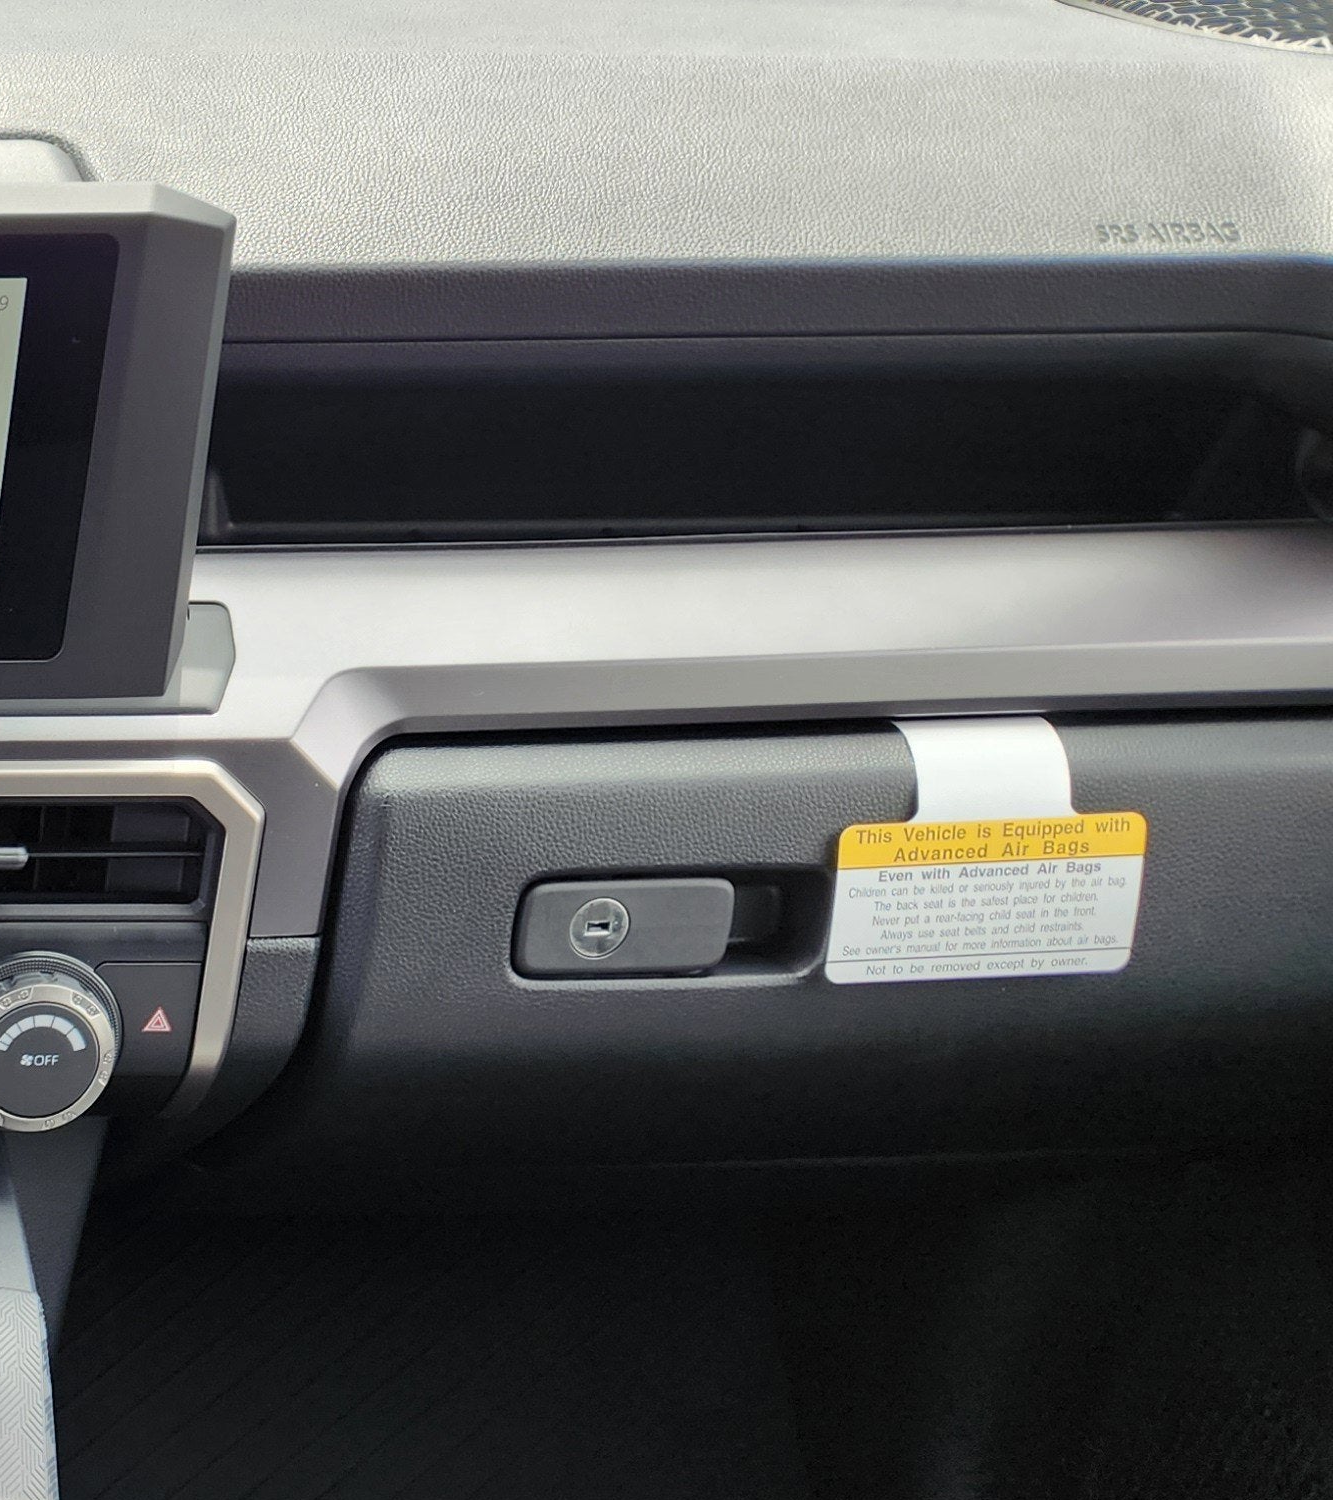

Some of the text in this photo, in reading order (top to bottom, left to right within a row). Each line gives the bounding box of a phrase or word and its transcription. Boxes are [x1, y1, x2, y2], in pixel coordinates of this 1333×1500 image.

[1095, 222, 1241, 244] SRS AIRBAG
[856, 817, 1130, 844] This Vehicle is Equipped with
[893, 840, 1090, 862] Advanced Air Bags
[878, 861, 1102, 882] Even with Advanced Air Bags
[849, 885, 886, 899] Children
[891, 886, 908, 896] can
[913, 884, 926, 895] be
[929, 882, 954, 895] killed
[958, 884, 969, 893] or
[973, 879, 1014, 894] seriously
[1019, 879, 1050, 892] injured
[1055, 878, 1066, 889] by
[1071, 878, 1086, 887] the
[1090, 876, 1103, 887] air
[874, 901, 892, 911] The
[896, 900, 919, 911] back
[923, 899, 943, 910] seat
[948, 898, 956, 908] is
[961, 898, 976, 908] the
[981, 895, 1009, 907] safest
[1013, 895, 1038, 907] place
[1043, 893, 1056, 904] for
[872, 915, 900, 927] Never
[904, 915, 920, 927] put
[924, 915, 931, 924] a
[935, 911, 985, 925] rear-facing
[989, 909, 1012, 921] child
[1015, 909, 1036, 920] seat
[1040, 908, 1050, 918] in
[1054, 907, 1069, 917] the
[880, 929, 913, 942] Always
[918, 929, 935, 938] use
[939, 926, 960, 937] seat
[964, 926, 987, 936] belts
[991, 924, 1009, 935] and
[1014, 923, 1036, 933] child
[842, 946, 861, 957] See
[865, 944, 902, 955] owner's
[906, 941, 941, 953] manual
[945, 941, 958, 952] for
[962, 941, 987, 950] more
[991, 936, 1042, 949] information
[1046, 936, 1072, 947] about
[1077, 935, 1090, 945] air
[866, 965, 886, 976] Not
[893, 964, 904, 974] to
[910, 963, 925, 974] be
[931, 961, 981, 972] removed
[986, 958, 1025, 970] except
[1030, 957, 1045, 969] by
[34, 1054, 60, 1067] OFF
